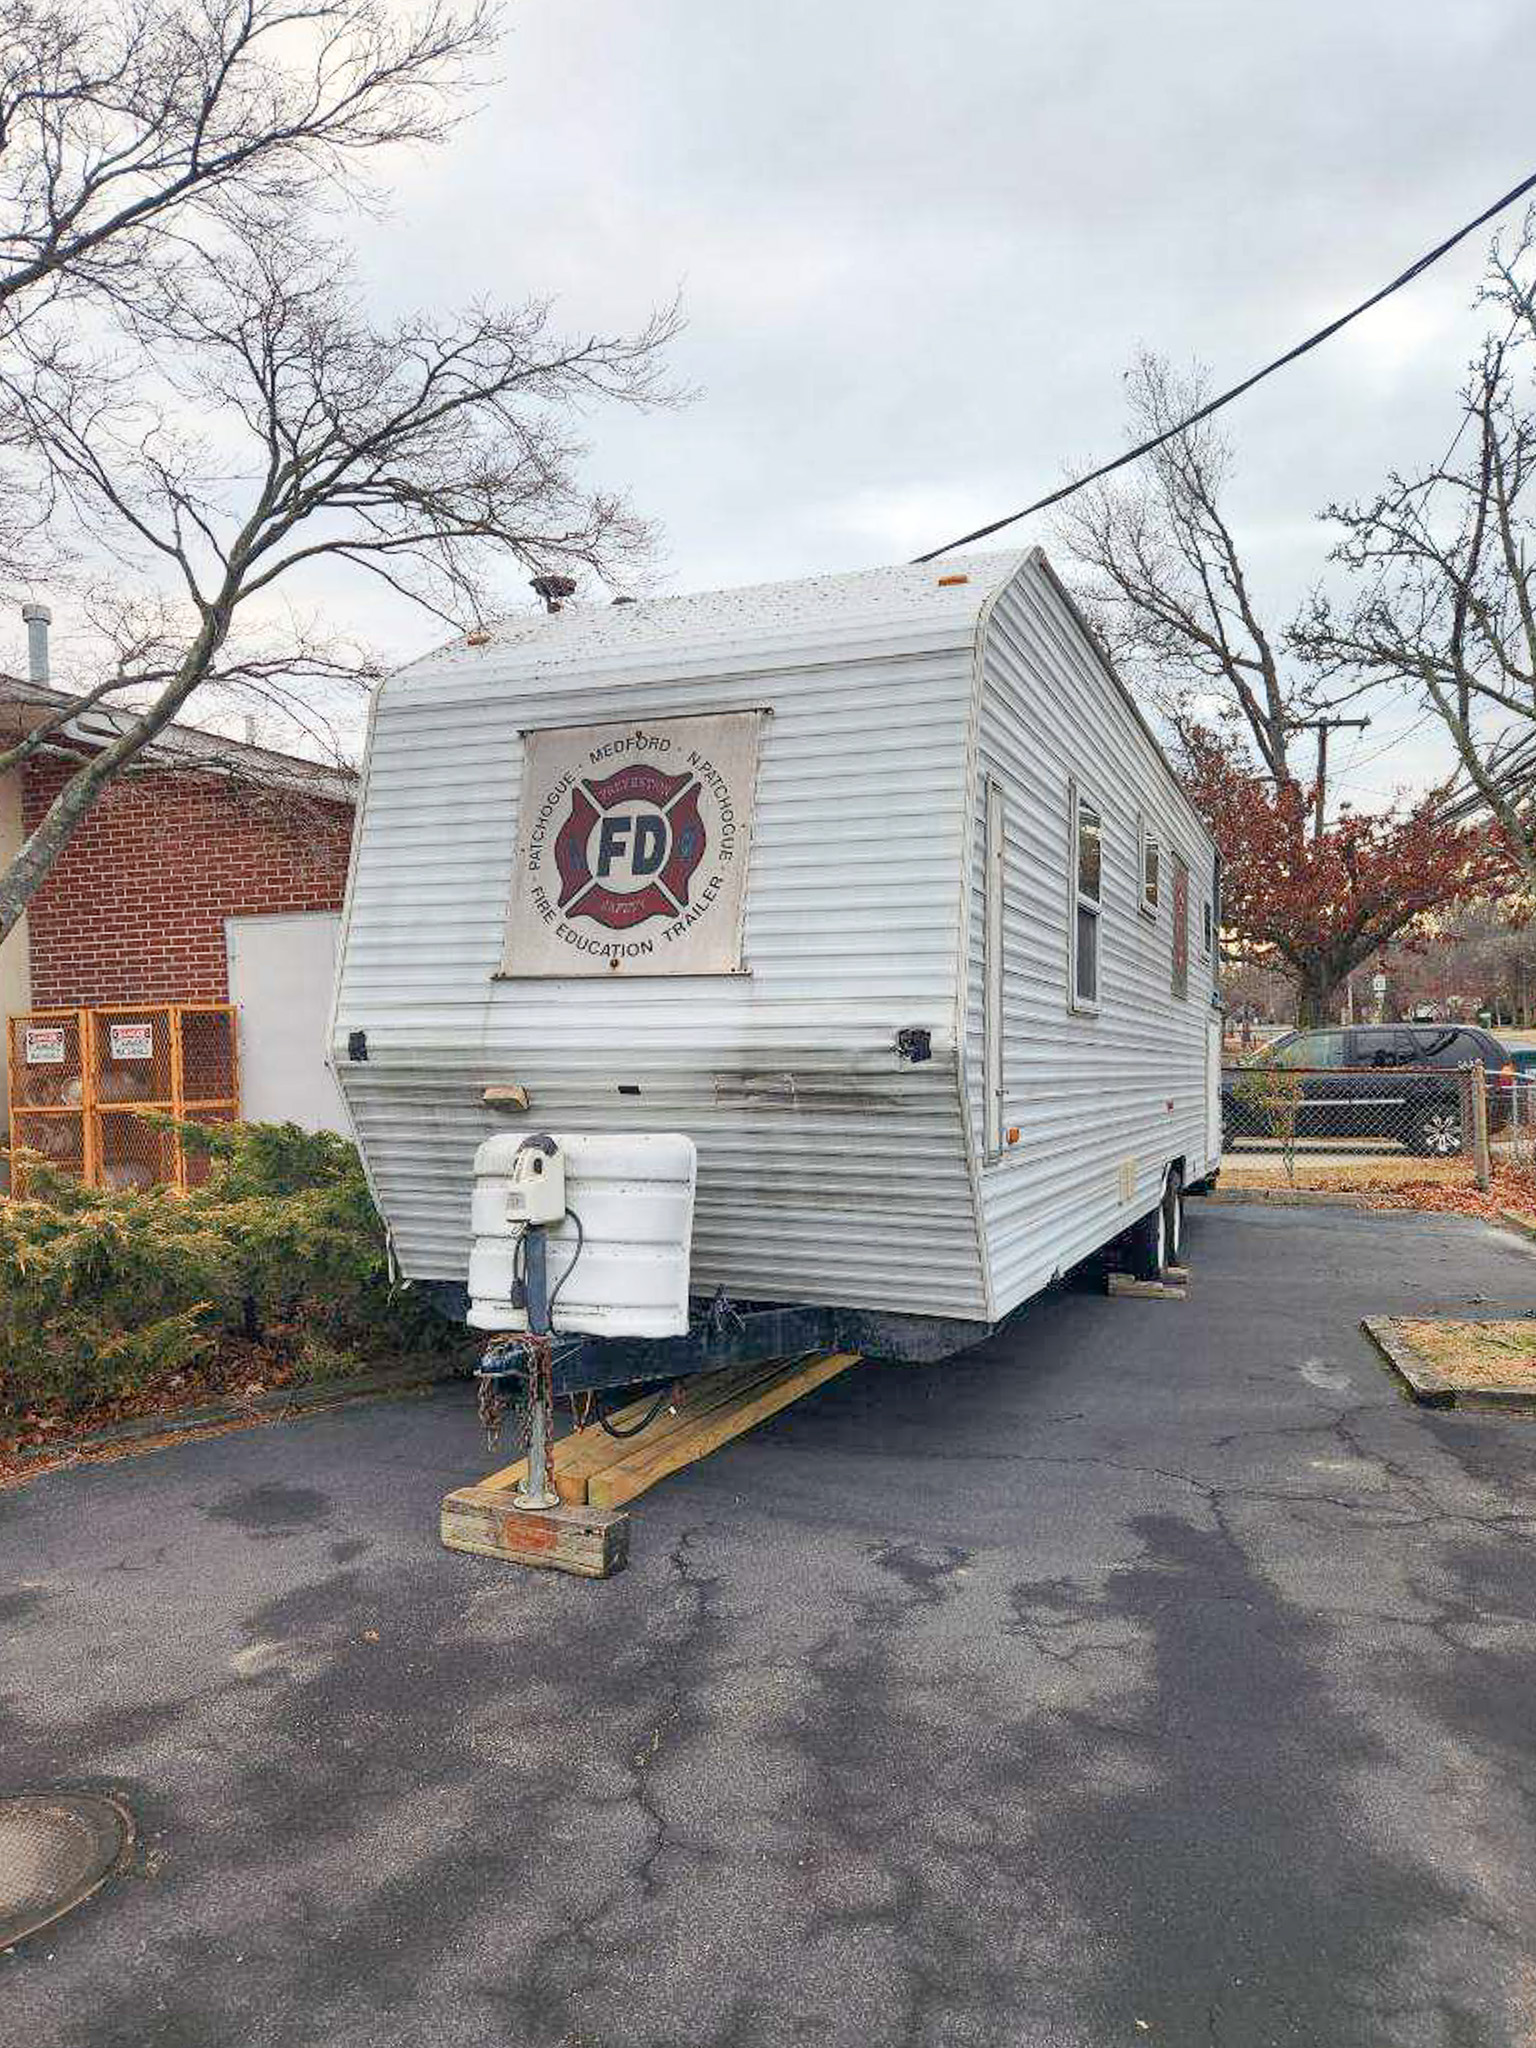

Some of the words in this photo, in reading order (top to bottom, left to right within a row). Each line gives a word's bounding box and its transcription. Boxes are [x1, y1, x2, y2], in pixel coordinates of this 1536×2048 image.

[528, 769, 577, 871] PATCHOGUE
[589, 735, 671, 764] MEDFORD
[597, 814, 667, 877] FD
[530, 885, 557, 926] FIRE
[556, 922, 654, 958] EDUCATION
[661, 875, 722, 942] TRAILER
